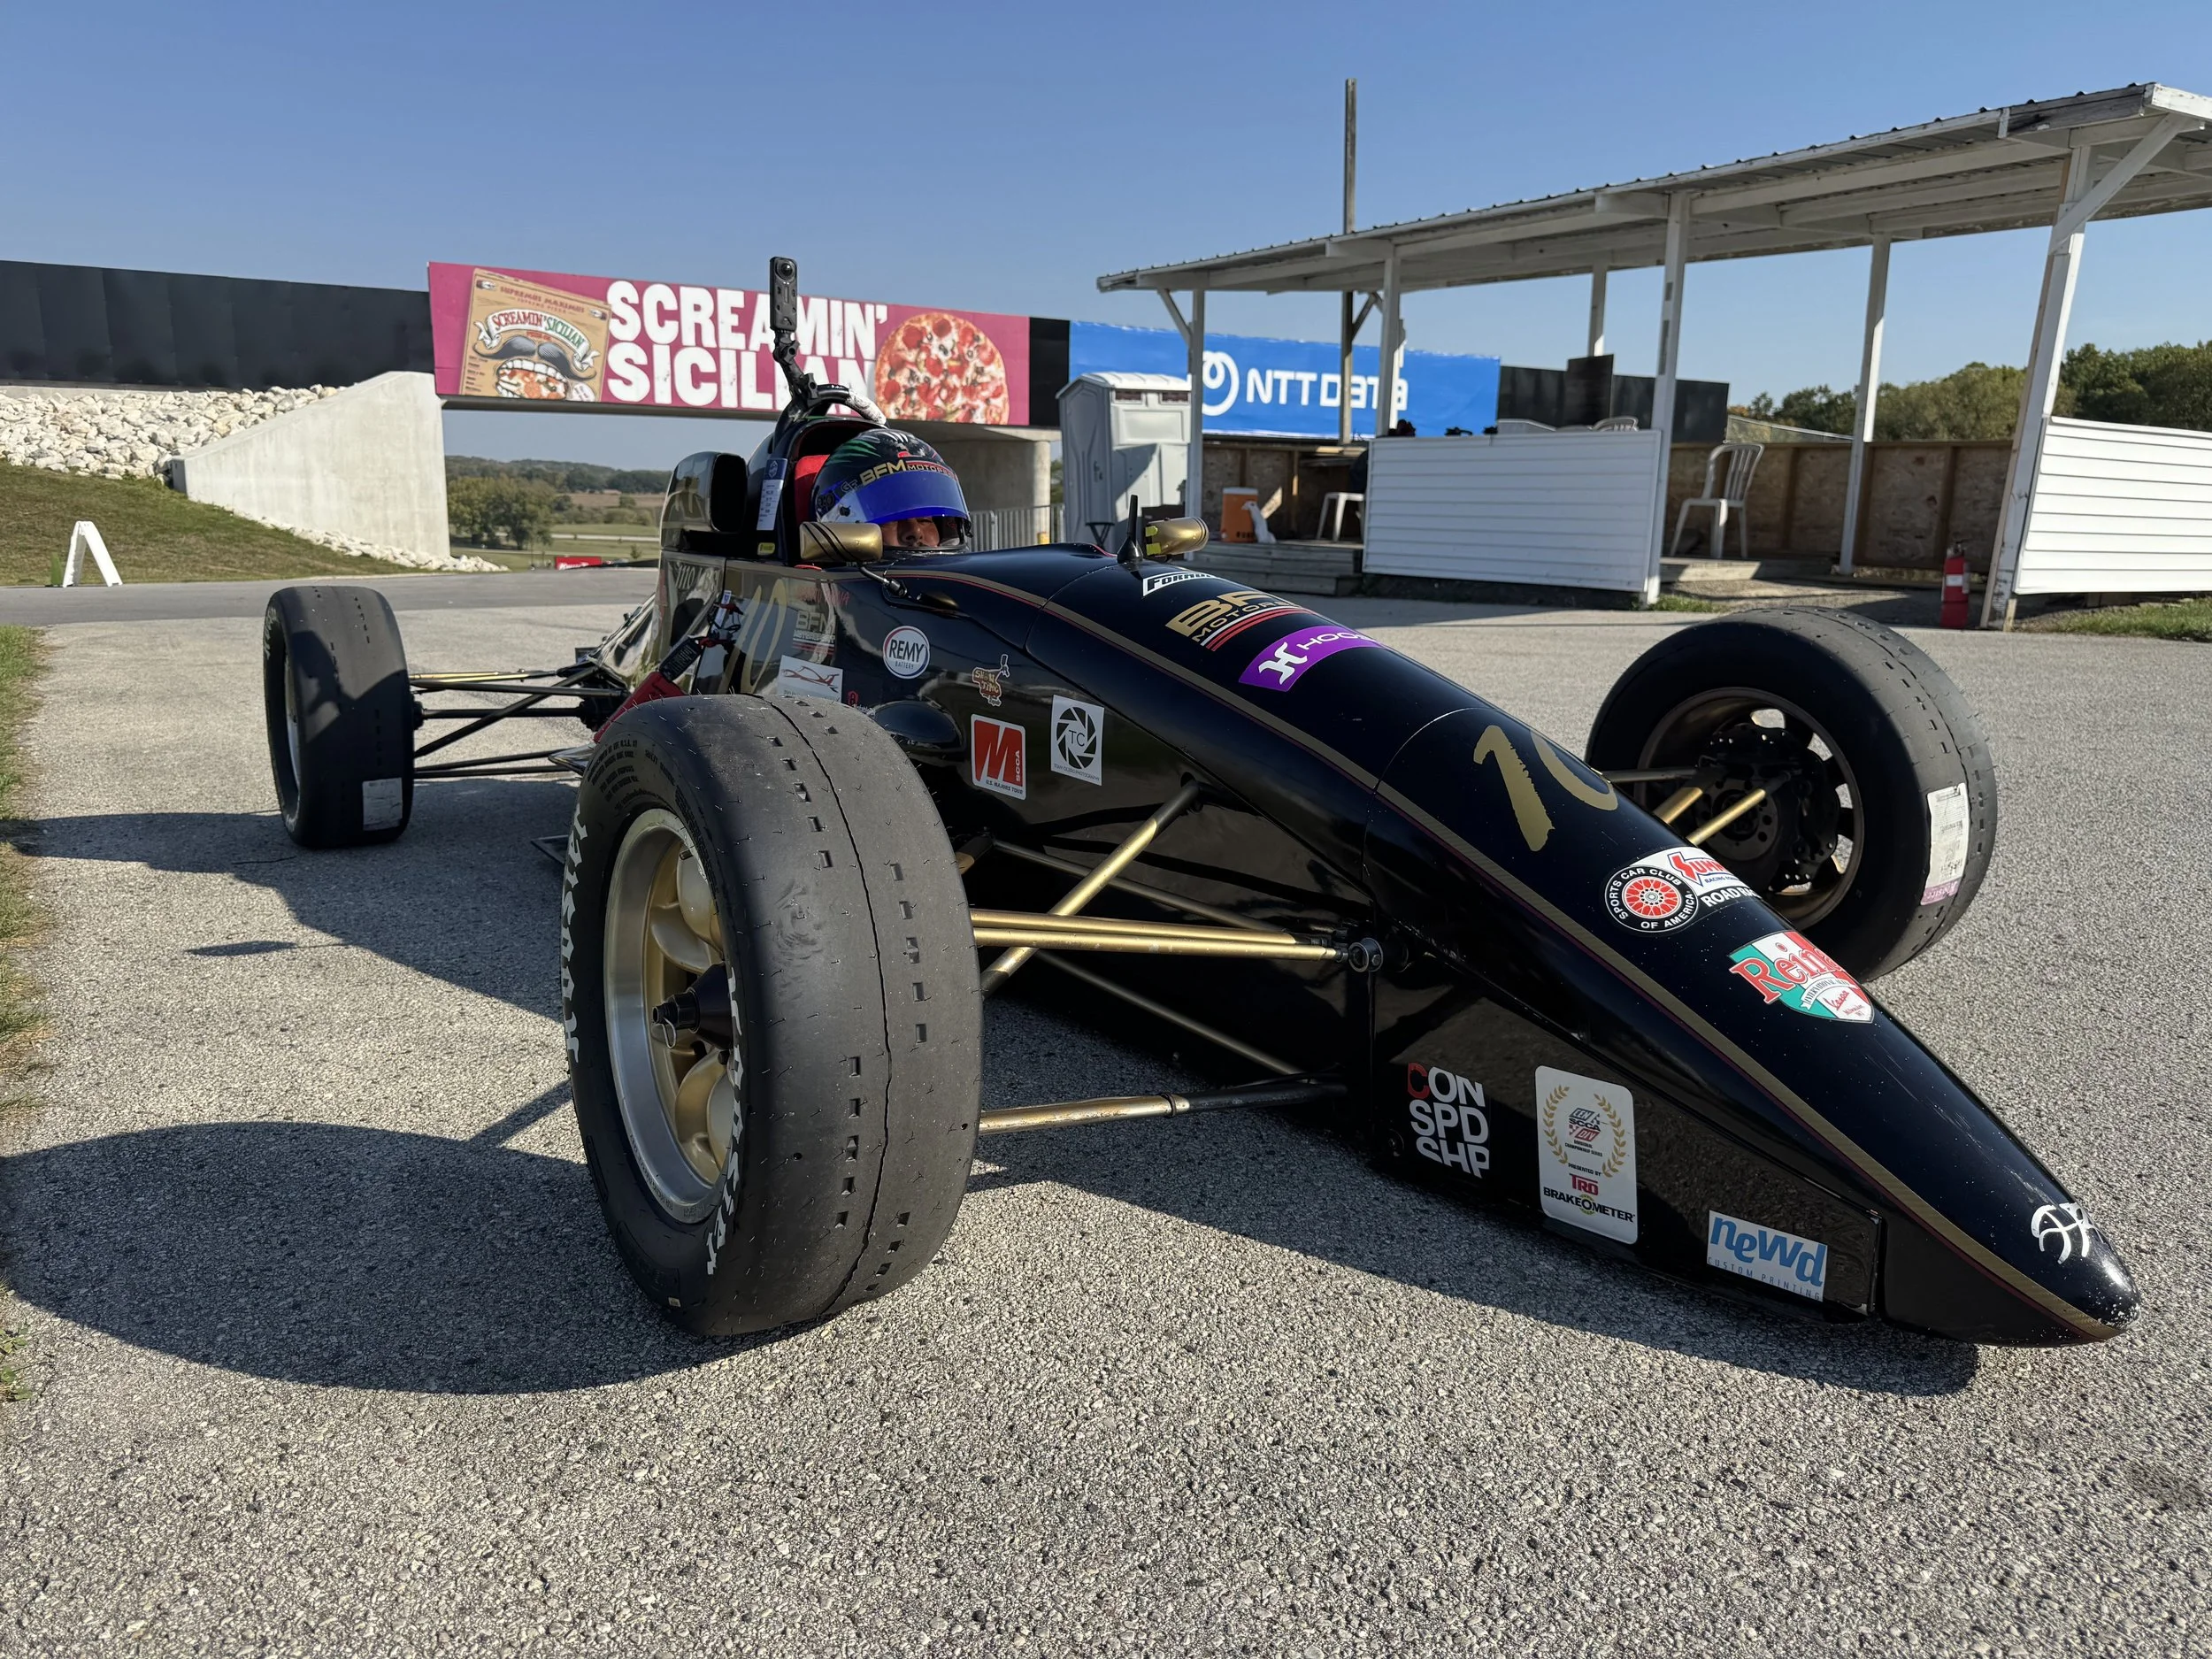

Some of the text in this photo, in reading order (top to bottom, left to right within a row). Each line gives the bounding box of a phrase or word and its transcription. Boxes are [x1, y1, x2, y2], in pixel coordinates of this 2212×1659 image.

[544, 317, 586, 349] SICILIAN
[607, 280, 888, 361] SCREAMIN'
[607, 342, 873, 414] SICILIAN
[1246, 367, 1318, 406] NTT
[859, 459, 907, 486] BFM
[1164, 590, 1273, 637] BF
[888, 639, 925, 663] REMY
[895, 660, 914, 670] BATTERY
[1068, 729, 1085, 747] TC
[1671, 855, 1730, 881] SUMM
[1609, 866, 1682, 920] SPORTS CAR CLUB
[1700, 887, 1740, 908] ROAD
[1640, 892, 1695, 930] OF AMERICA
[1803, 979, 1836, 1005] INTERNATIONAL
[1822, 989, 1850, 1011] Vespa
[1407, 1062, 1486, 1107] CON
[1409, 1099, 1489, 1143] SPD
[1569, 1118, 1601, 1132] SCCA
[1572, 1109, 1592, 1121] CEN
[1578, 1129, 1597, 1141] DIV
[1416, 1137, 1490, 1179] SHP
[1568, 1163, 1594, 1175] PRESENTED
[1569, 1172, 1599, 1196] TRD
[1708, 1256, 1821, 1302] CUSTOM PRINTING
